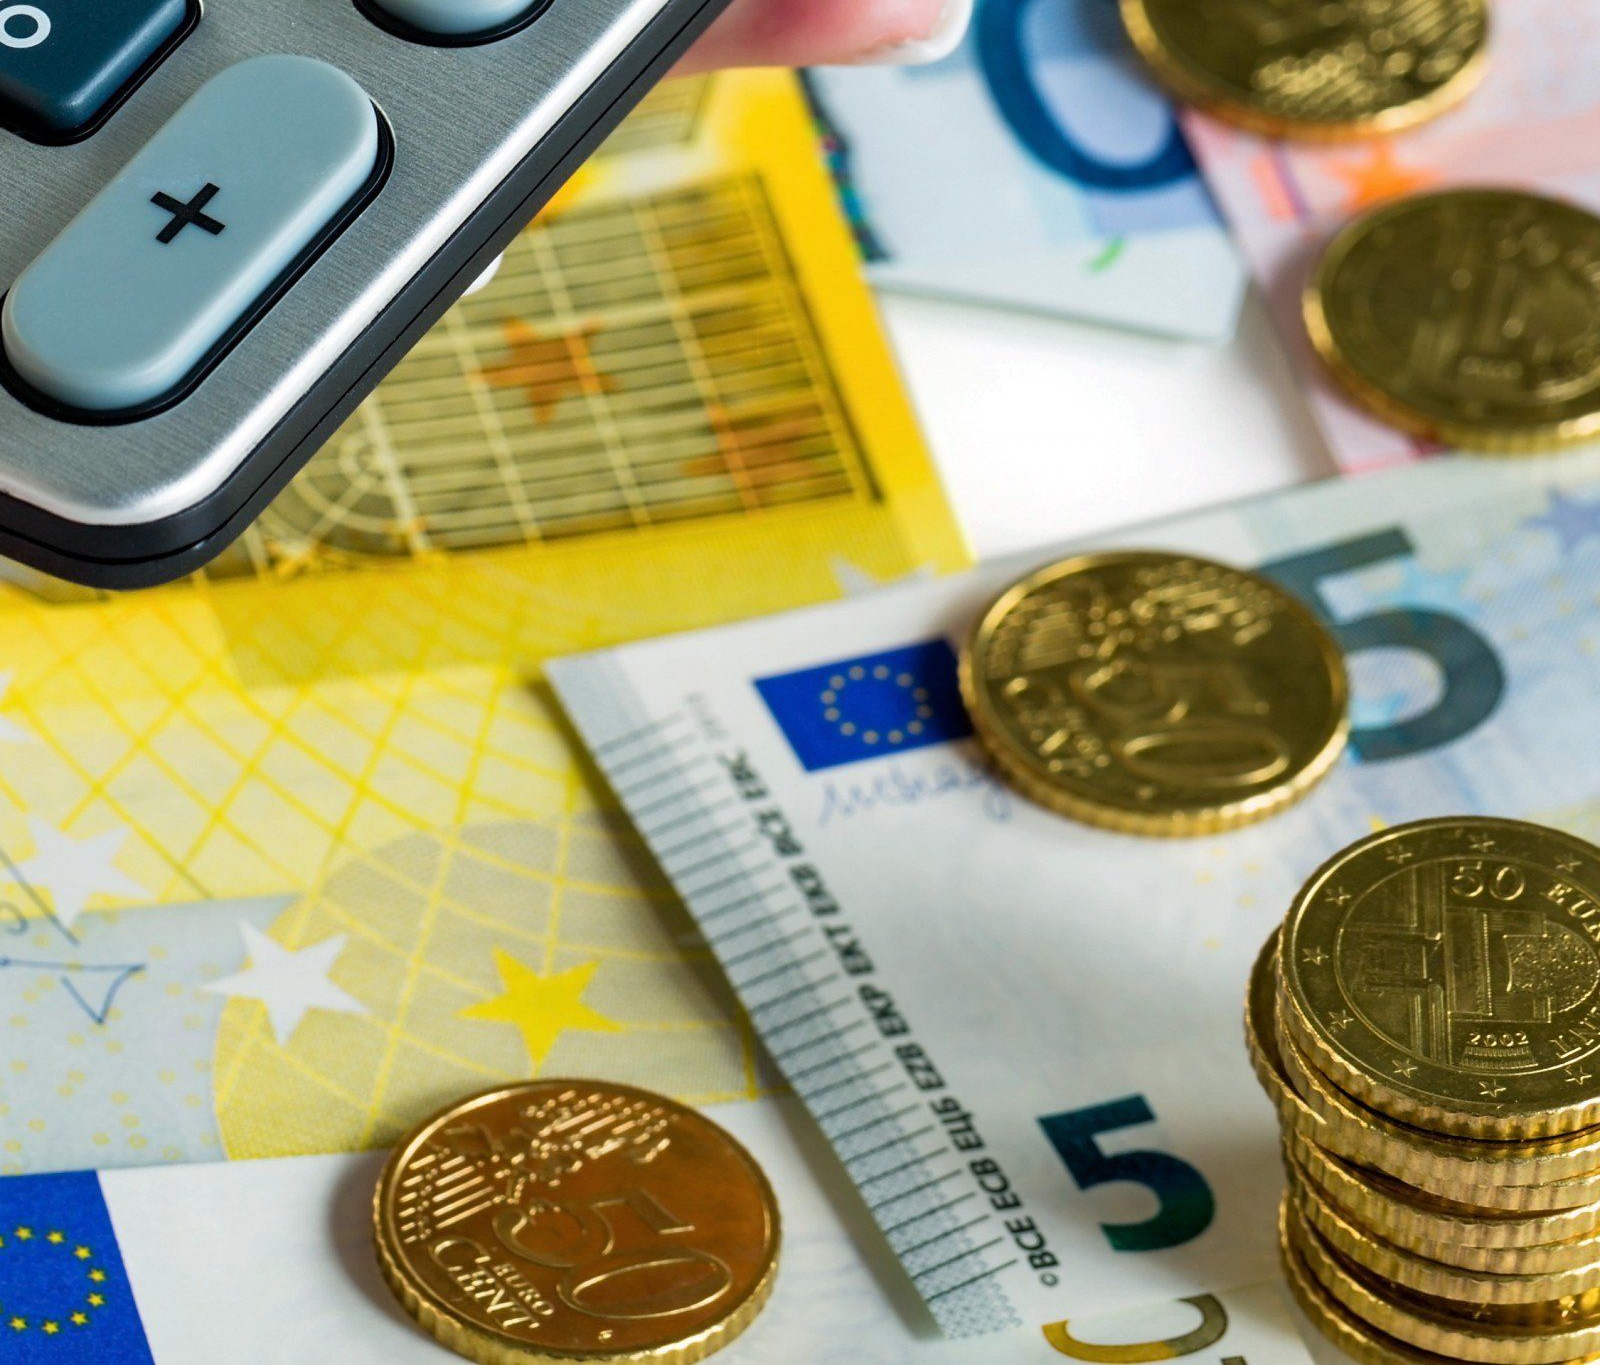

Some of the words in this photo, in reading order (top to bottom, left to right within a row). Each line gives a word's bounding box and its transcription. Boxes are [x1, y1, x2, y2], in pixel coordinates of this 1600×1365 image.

[1257, 521, 1507, 764] 5
[1451, 860, 1526, 901] 50
[822, 924, 876, 978] EKT
[857, 983, 912, 1039] EKP
[1469, 1032, 1529, 1046] 2002
[894, 1042, 946, 1092] EZB
[968, 1156, 1022, 1212] ECB
[1035, 1092, 1216, 1253] 5
